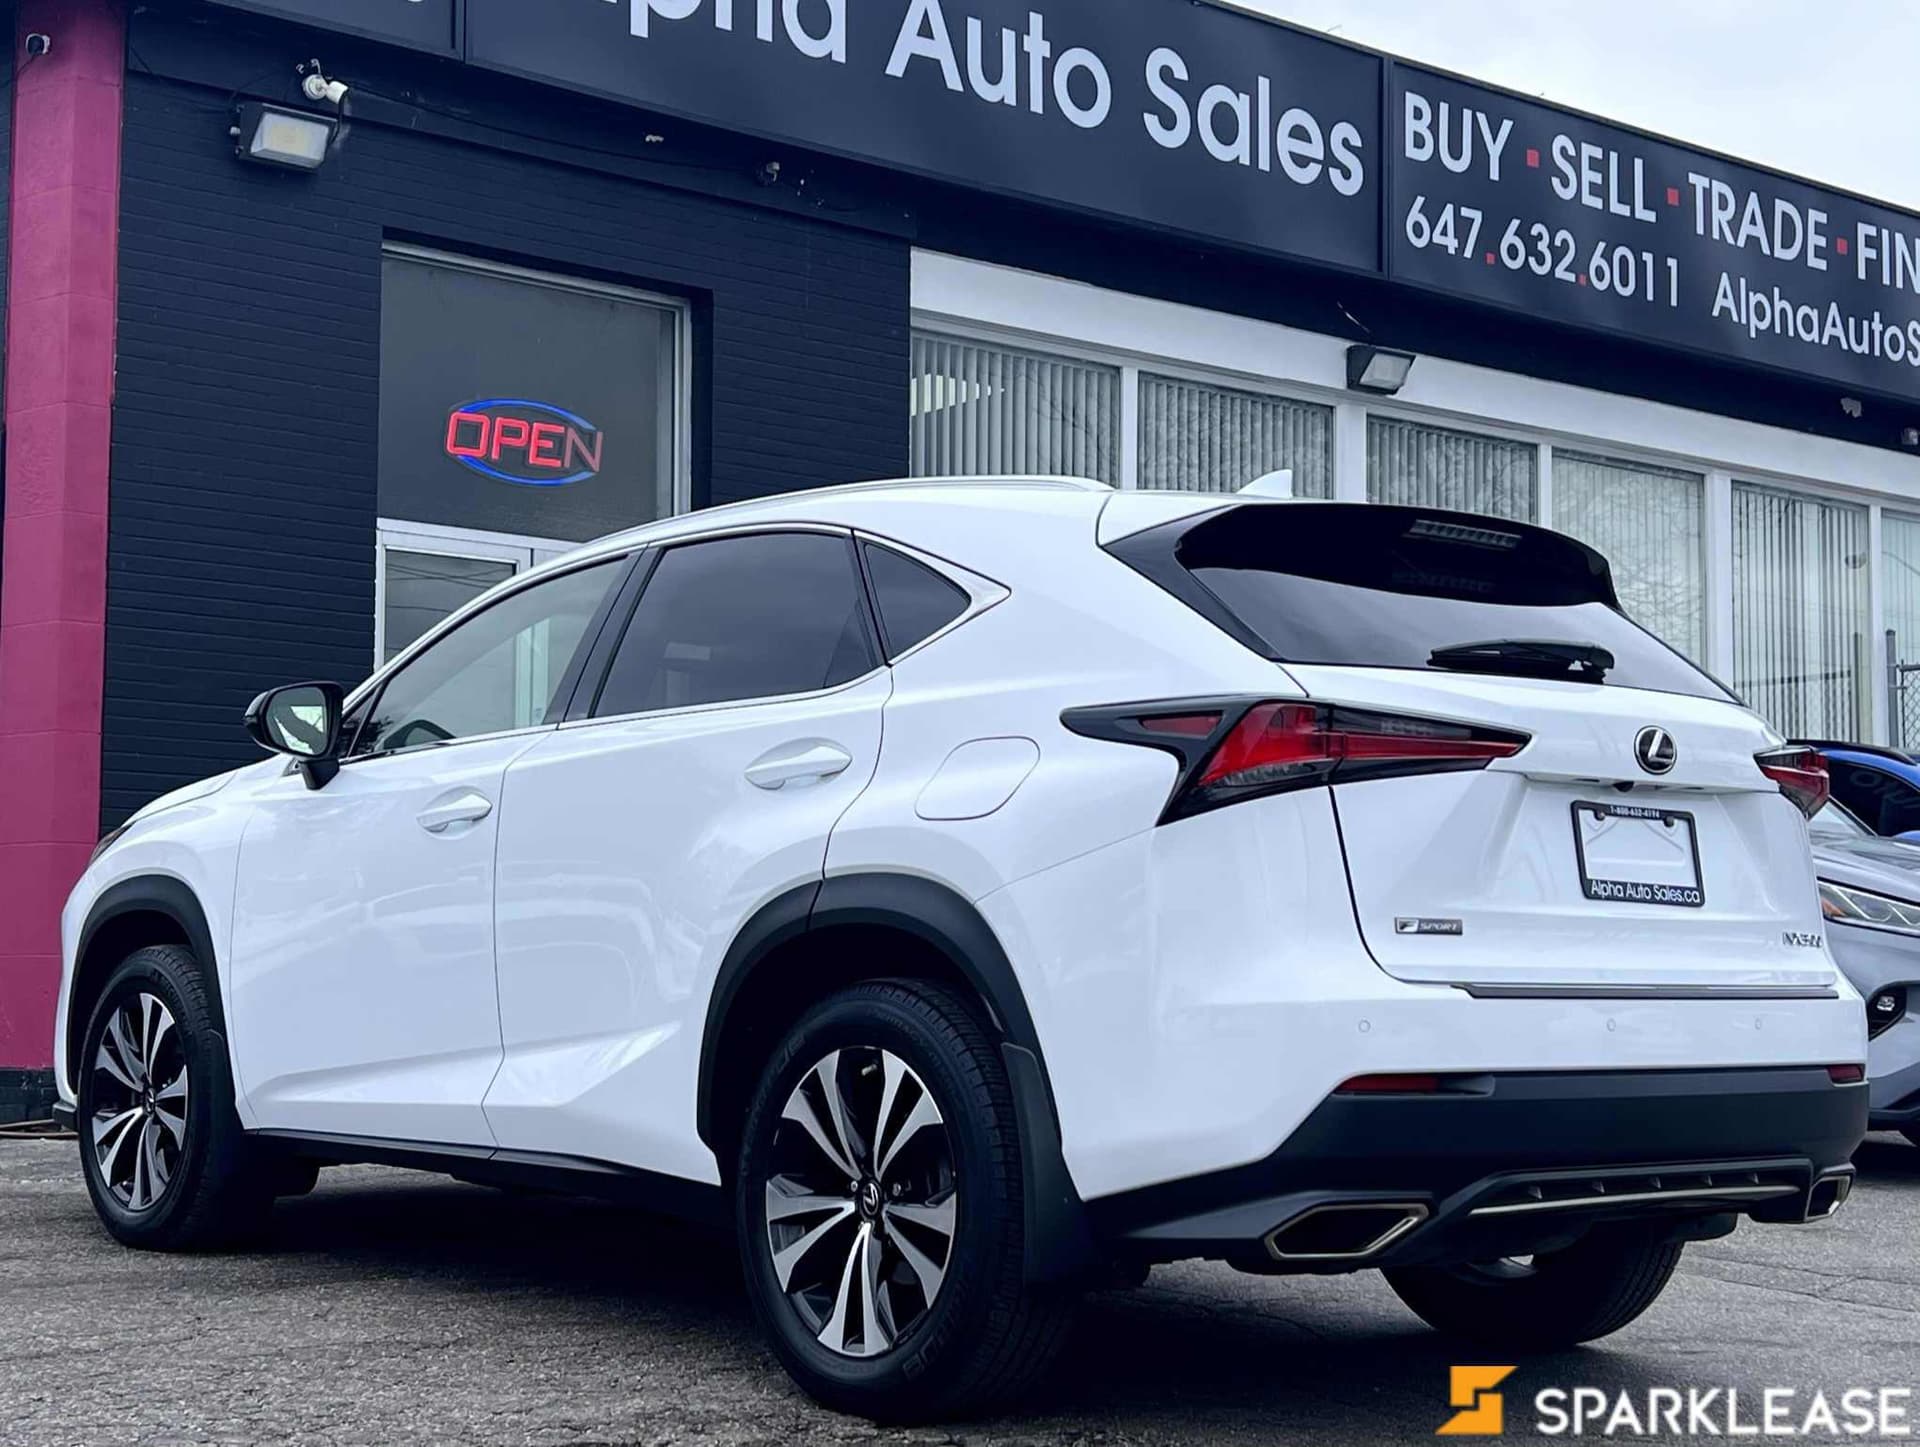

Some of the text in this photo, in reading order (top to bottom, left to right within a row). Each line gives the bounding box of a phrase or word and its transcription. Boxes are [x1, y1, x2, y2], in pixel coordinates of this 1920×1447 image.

[885, 0, 1112, 129] Auto
[1143, 46, 1365, 197] Sales
[1404, 91, 1920, 294] BUY SELL TRADE FIN
[446, 411, 604, 473] OPEN
[1591, 879, 1624, 899] Alpha
[1625, 882, 1652, 900] Auto
